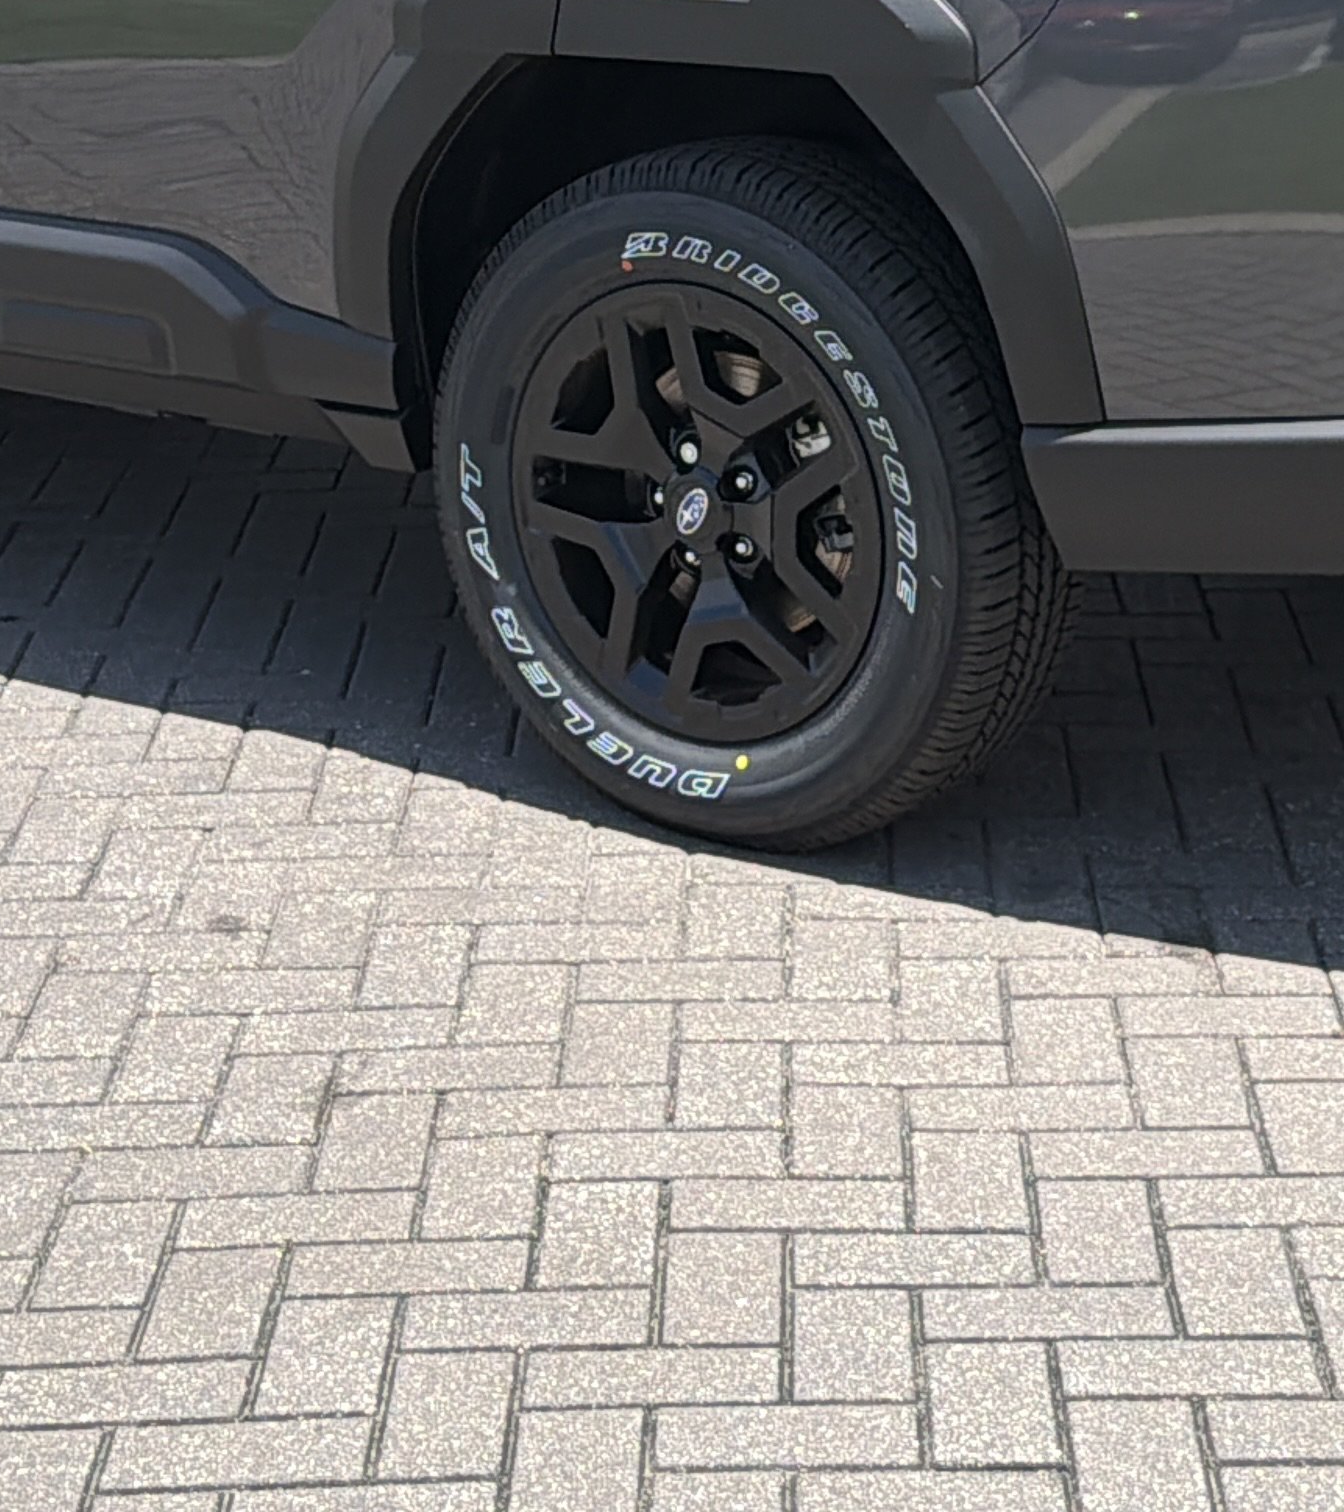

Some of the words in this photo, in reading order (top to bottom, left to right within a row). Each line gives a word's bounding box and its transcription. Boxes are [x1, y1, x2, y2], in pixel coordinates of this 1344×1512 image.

[460, 442, 500, 581] A/T
[621, 231, 918, 615] BRIDGESTONE
[491, 605, 731, 800] DUELER
